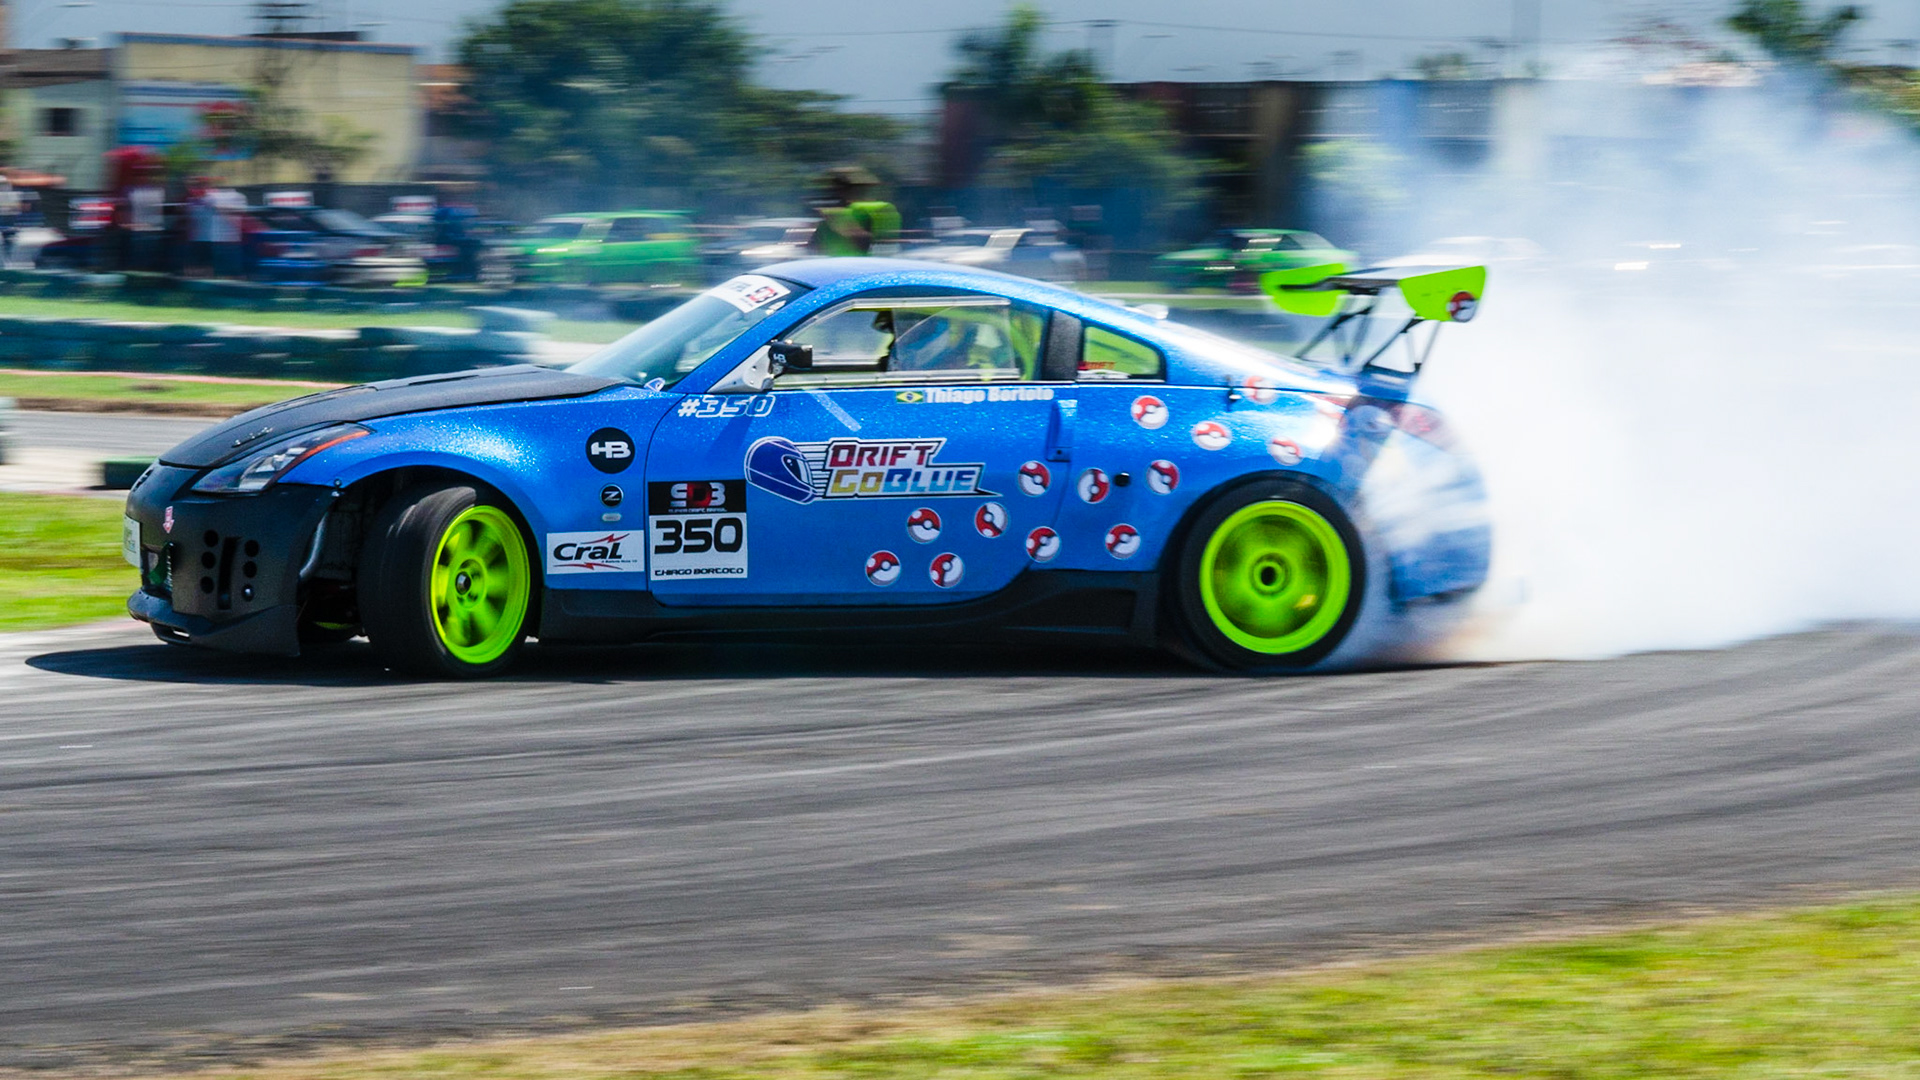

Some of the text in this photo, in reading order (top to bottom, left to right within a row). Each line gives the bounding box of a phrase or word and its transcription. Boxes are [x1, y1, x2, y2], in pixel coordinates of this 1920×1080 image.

[678, 395, 776, 418] #350
[925, 388, 985, 404] Thiago
[829, 444, 934, 468] DRIFT
[654, 517, 743, 555] 350
